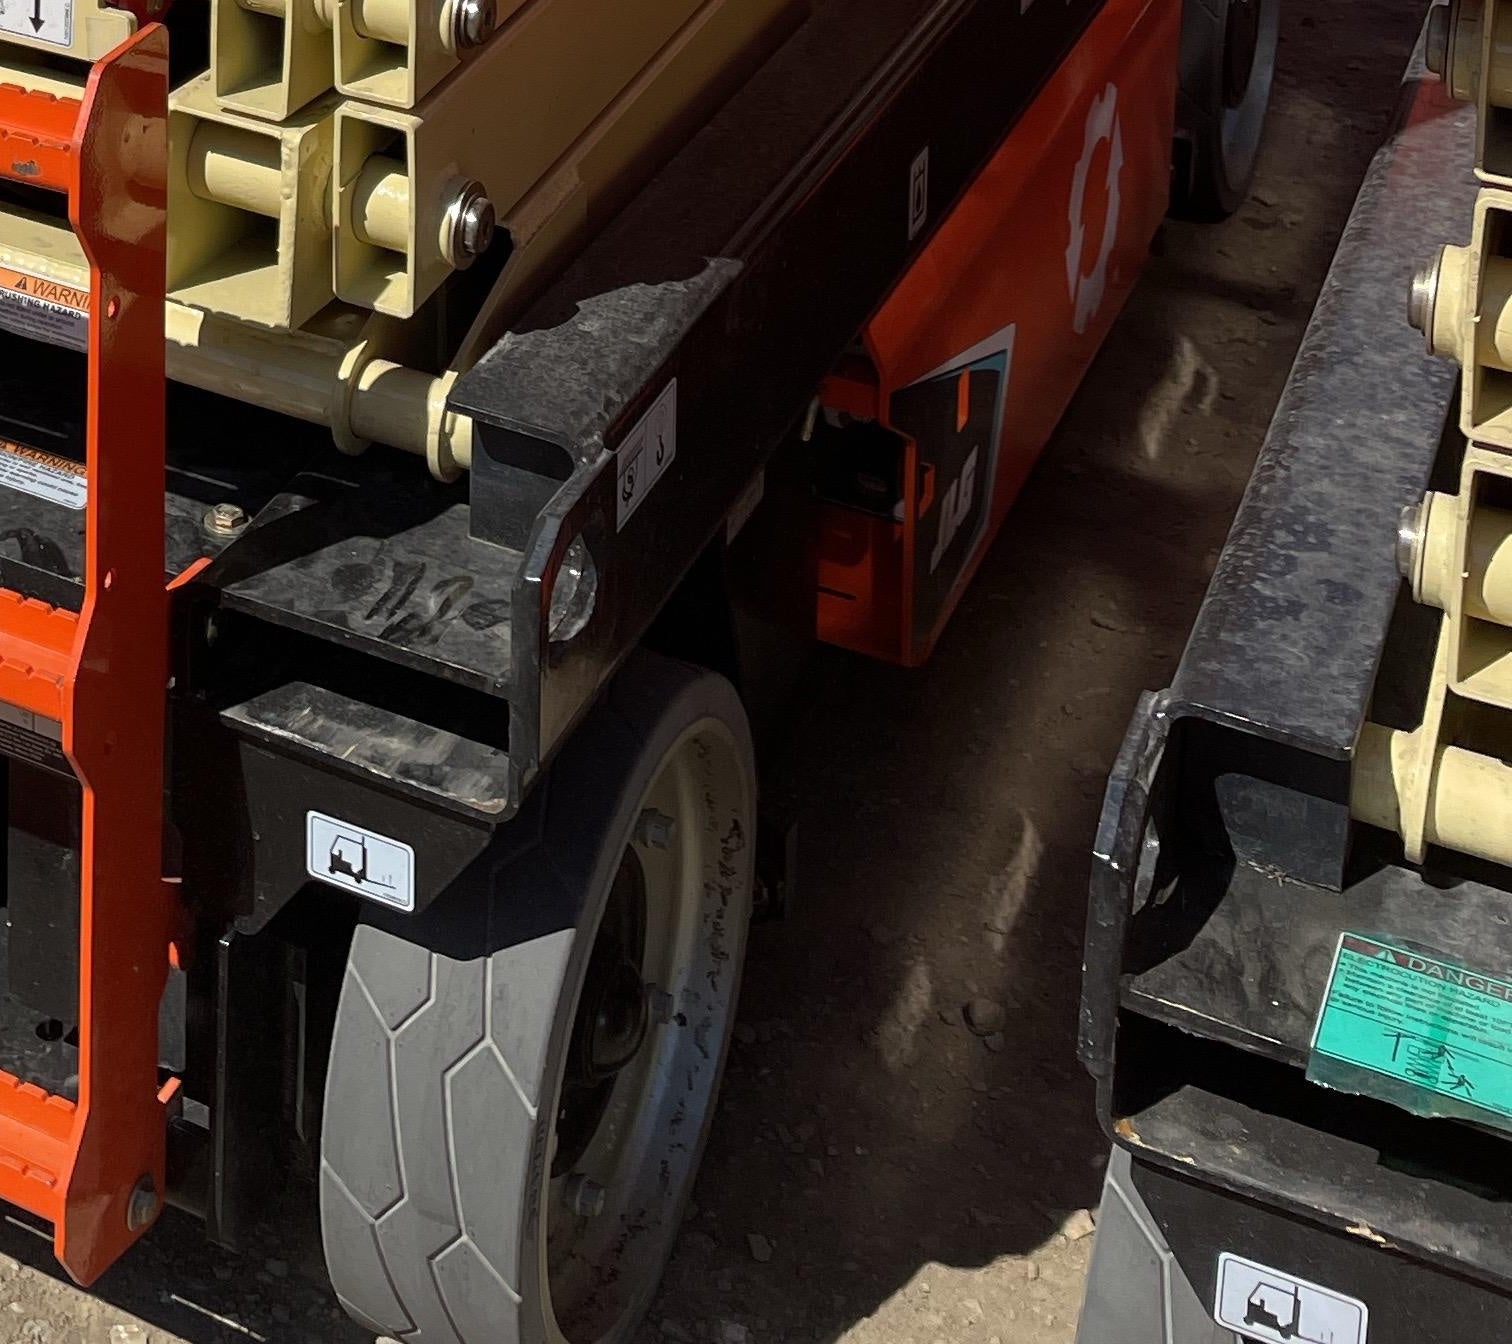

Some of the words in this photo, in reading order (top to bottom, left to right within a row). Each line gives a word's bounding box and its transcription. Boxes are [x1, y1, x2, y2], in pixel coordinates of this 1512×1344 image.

[32, 279, 90, 312] WARNI
[42, 301, 82, 320] HAZARD
[14, 441, 88, 477] WARNING
[1342, 952, 1446, 990] ELECTROCUTION
[1449, 986, 1501, 1008] HAZARD
